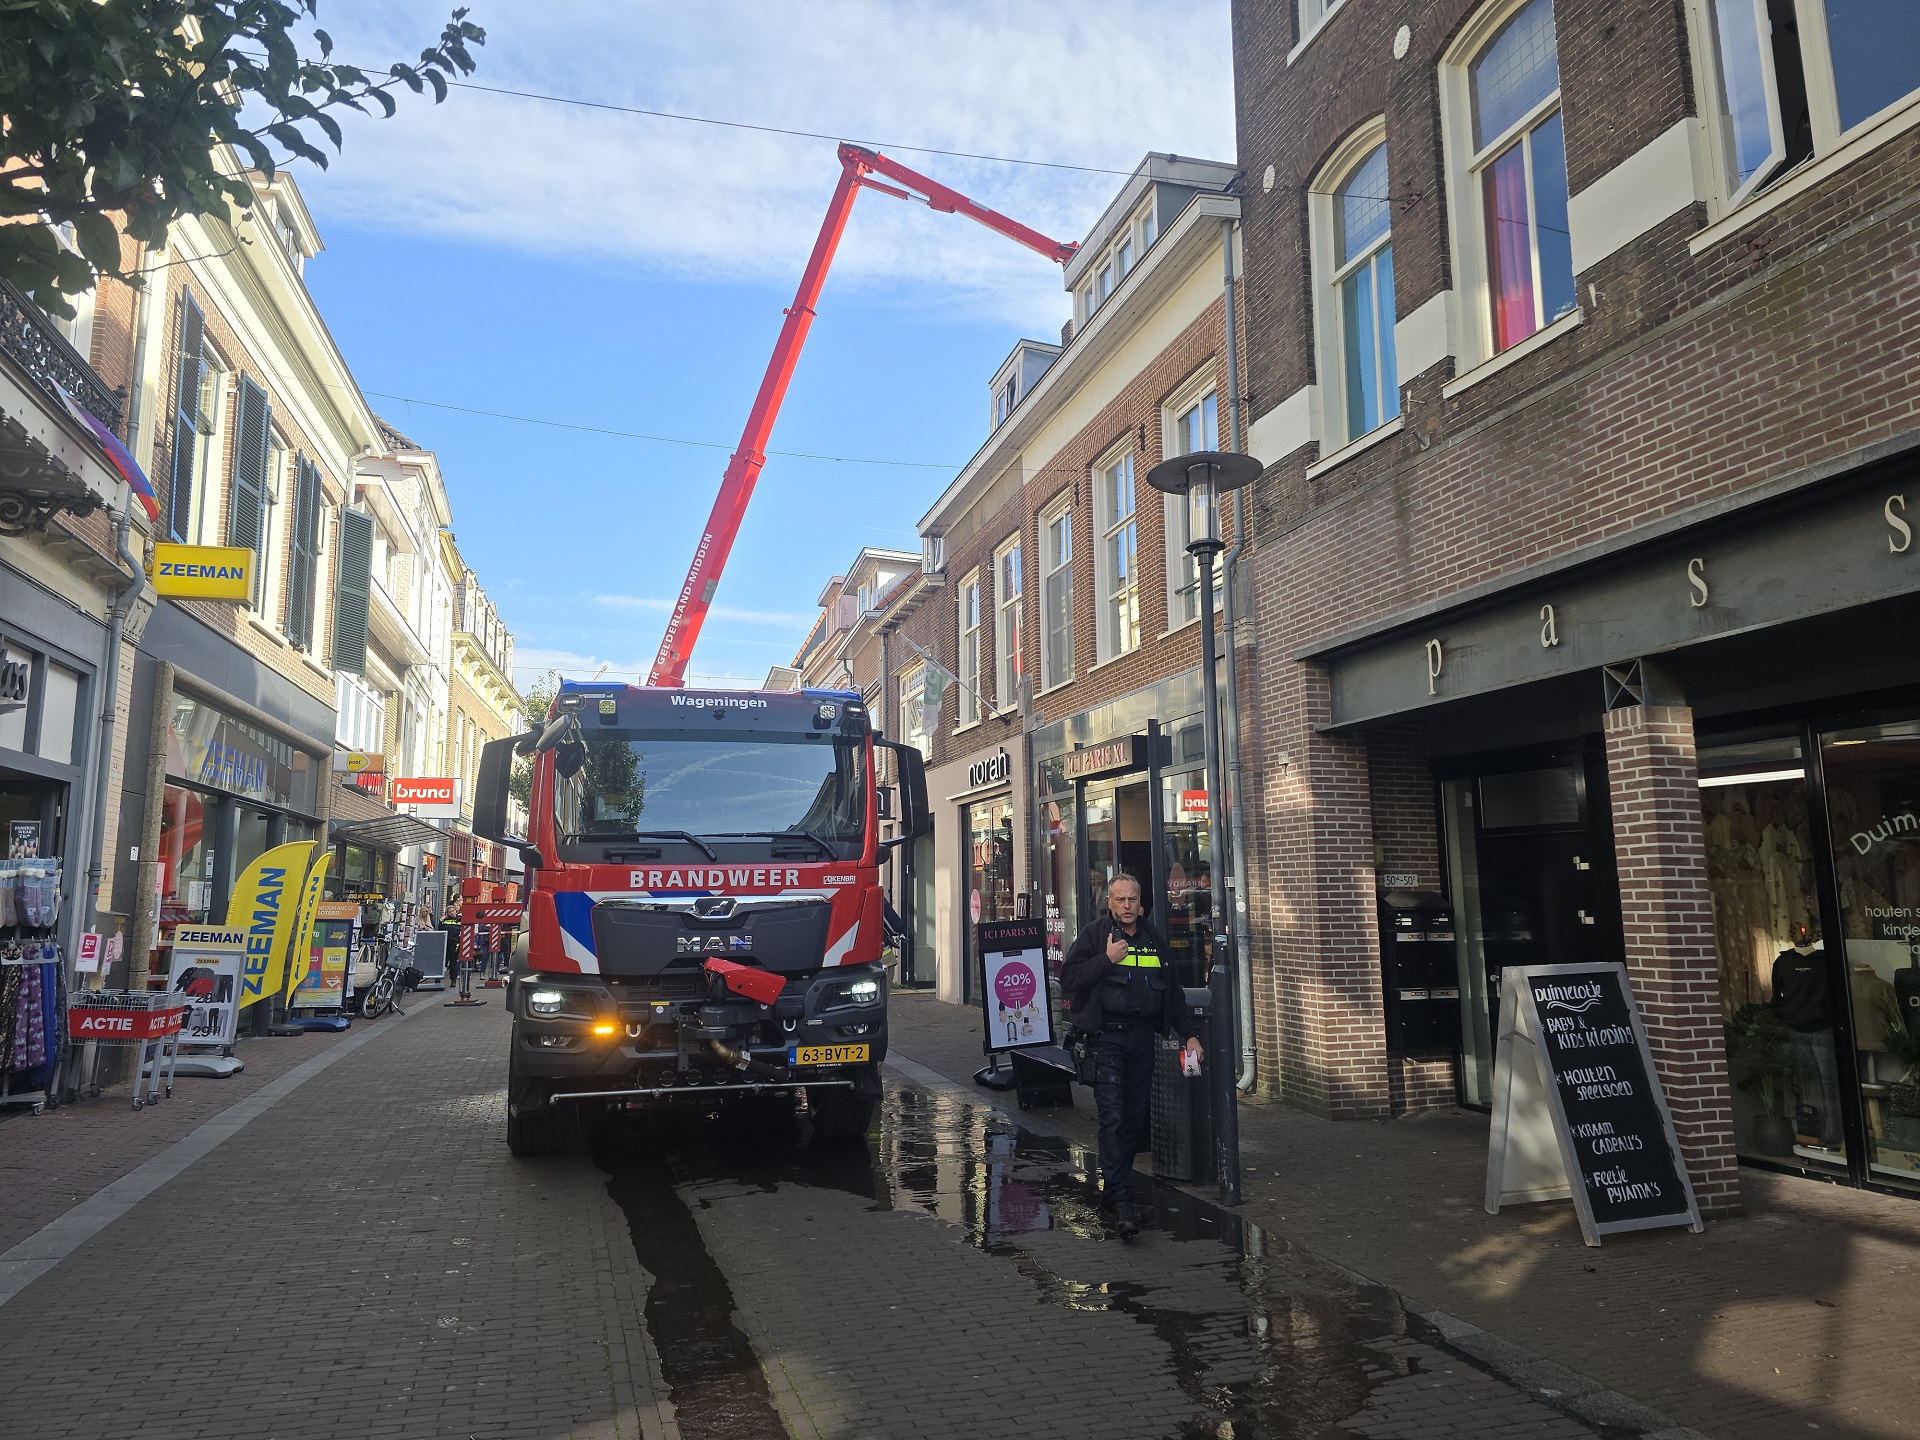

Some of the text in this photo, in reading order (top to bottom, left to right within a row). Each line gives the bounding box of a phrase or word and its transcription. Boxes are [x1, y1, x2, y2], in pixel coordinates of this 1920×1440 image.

[160, 562, 243, 580] ZEEMAN
[657, 533, 713, 665] GELDERLAND-MIDDEN
[670, 695, 768, 710] Wageningen
[1067, 742, 1128, 776] ICI PARIS XL
[968, 747, 1009, 788] norah
[396, 783, 450, 799] bruna
[1850, 813, 1920, 856] Duim
[629, 869, 800, 888] BRANDWEER
[1045, 894, 1055, 905] we
[1046, 905, 1060, 919] love
[1865, 905, 1912, 918] houten
[241, 868, 287, 997] ZEEMAN
[984, 926, 1039, 940] ICI PARIS XL
[1046, 919, 1065, 933] to see
[180, 931, 244, 944] ZEEMAN
[677, 935, 753, 953] MAN
[1047, 948, 1064, 962] shine
[999, 973, 1031, 987] -20%
[81, 1012, 184, 1031] ACTIE ACTIE ACTIE
[1546, 1015, 1588, 1034] BABY &
[802, 1046, 864, 1062] 63-BVT-2
